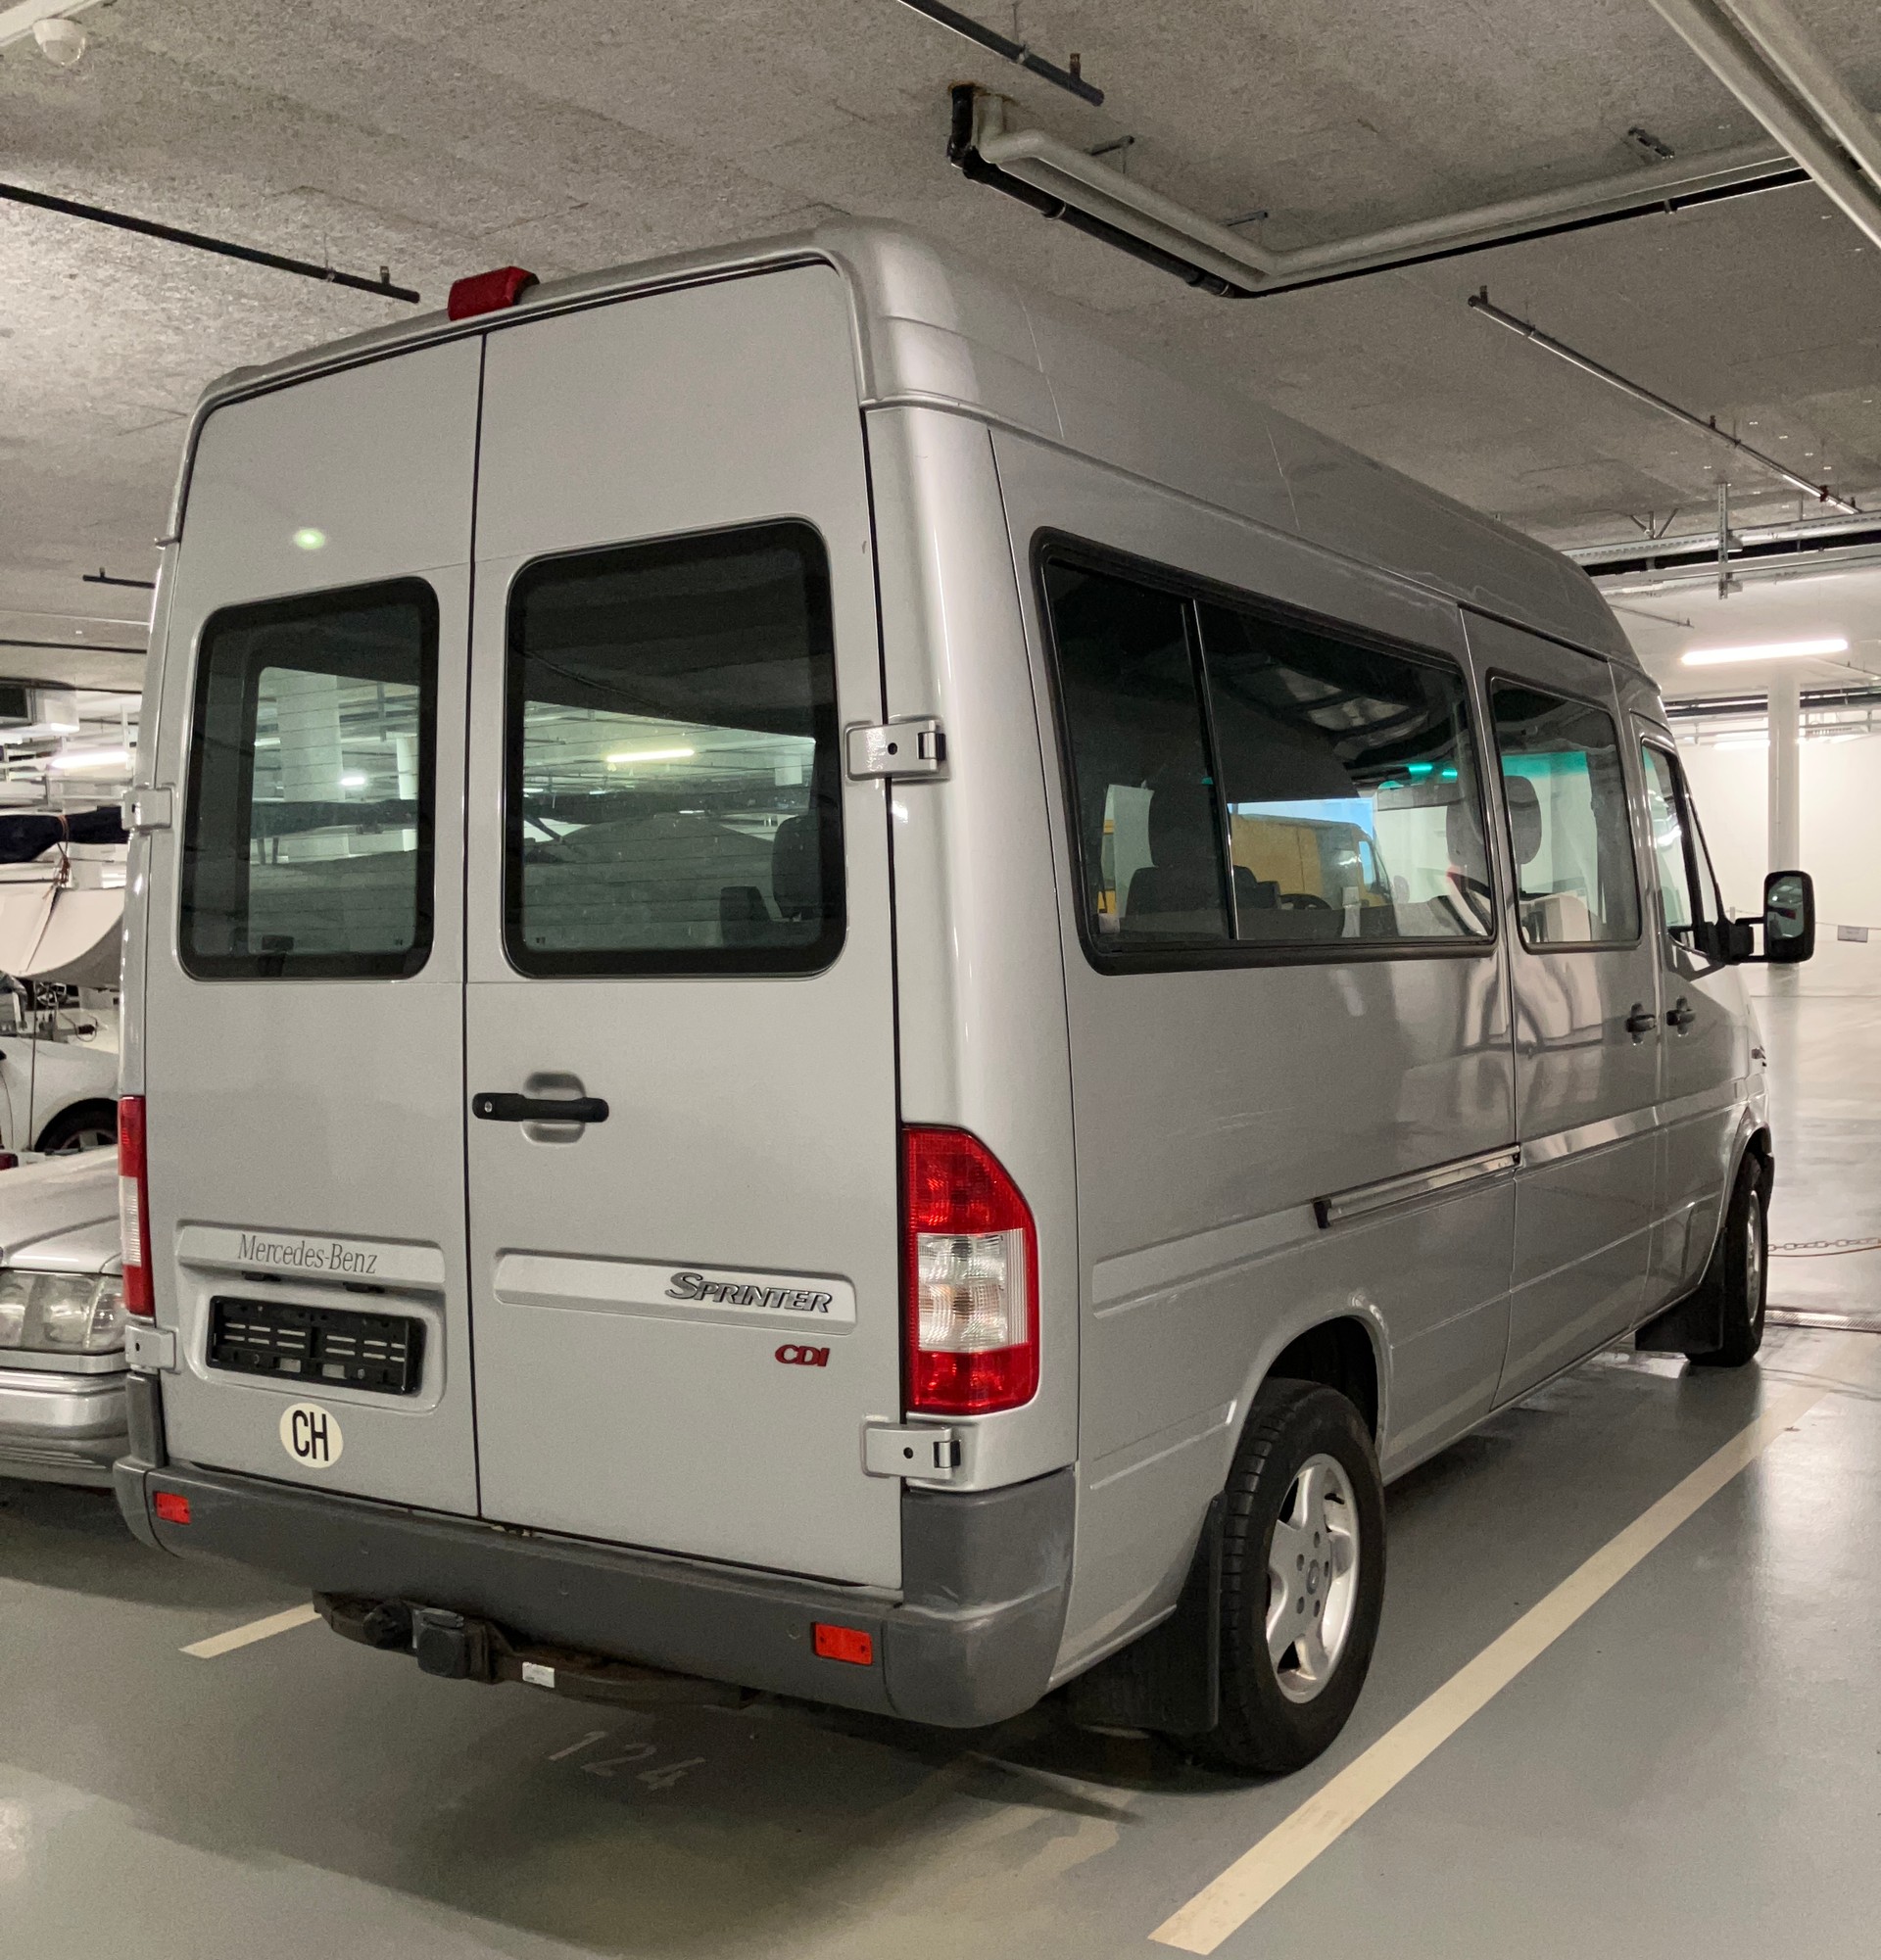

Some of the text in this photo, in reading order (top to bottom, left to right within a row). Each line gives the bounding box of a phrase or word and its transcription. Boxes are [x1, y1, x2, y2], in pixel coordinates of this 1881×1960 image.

[237, 1233, 378, 1274] Mercedes-Benz
[664, 1271, 833, 1314] SPRINTER
[774, 1344, 831, 1367] CDI
[291, 1410, 329, 1461] CH
[548, 1730, 707, 1792] 124
